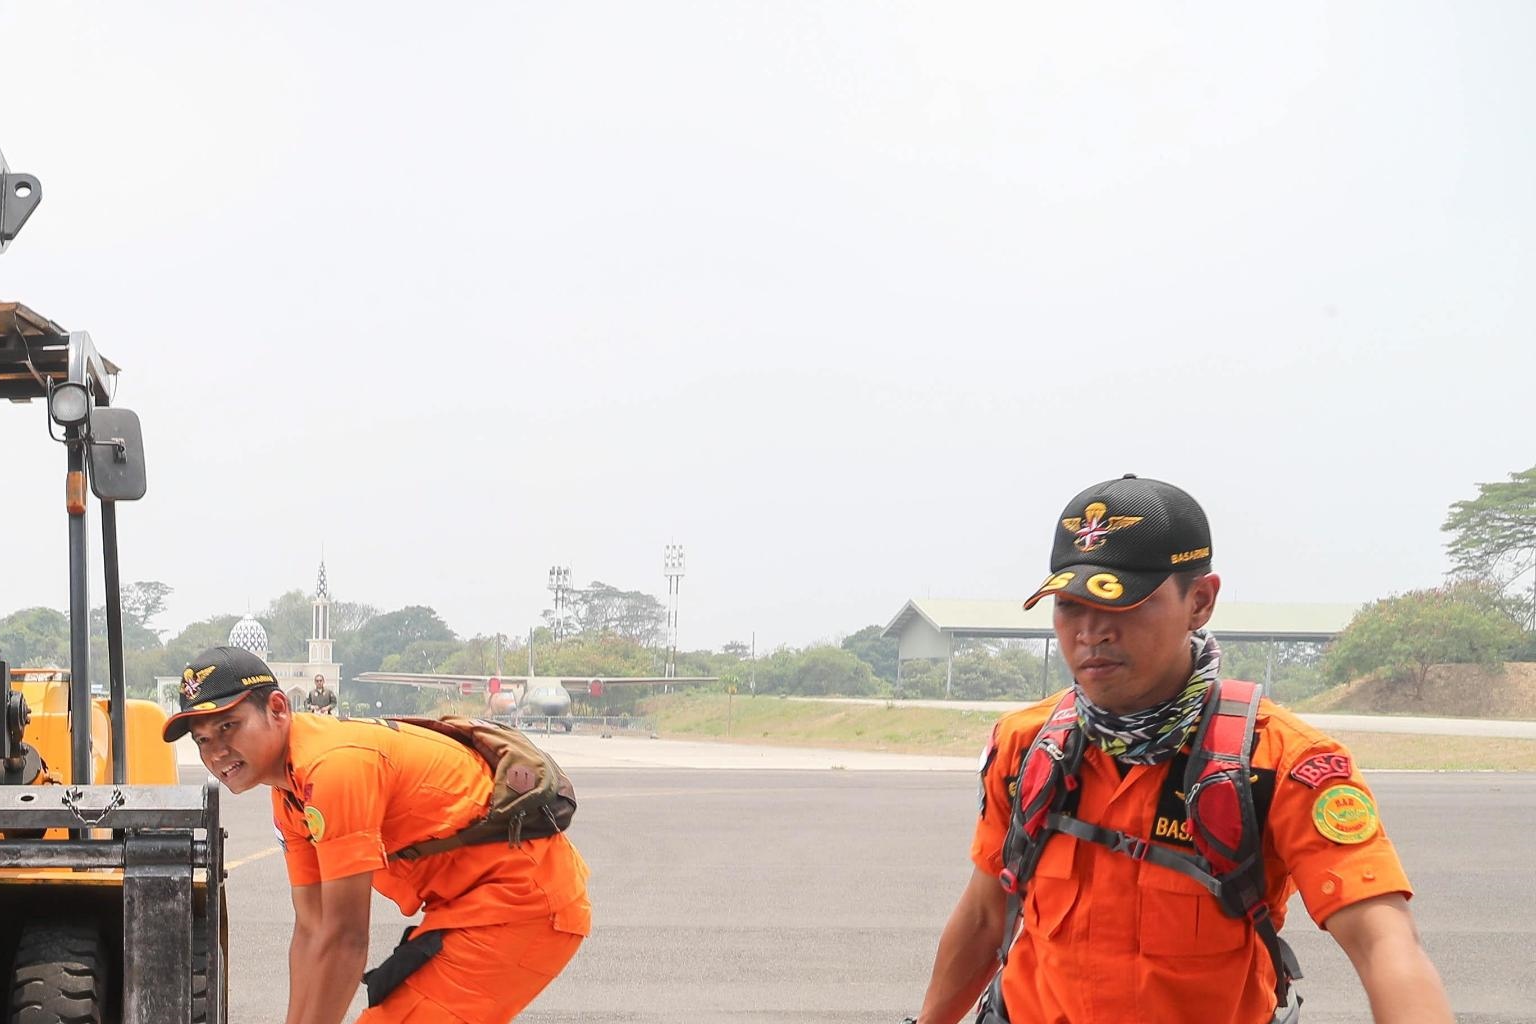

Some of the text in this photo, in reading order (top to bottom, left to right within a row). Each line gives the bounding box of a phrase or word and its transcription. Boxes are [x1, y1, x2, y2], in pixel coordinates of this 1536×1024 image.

[1040, 572, 1125, 600] SG
[1298, 755, 1348, 781] BSG
[1155, 816, 1193, 841] BAS
